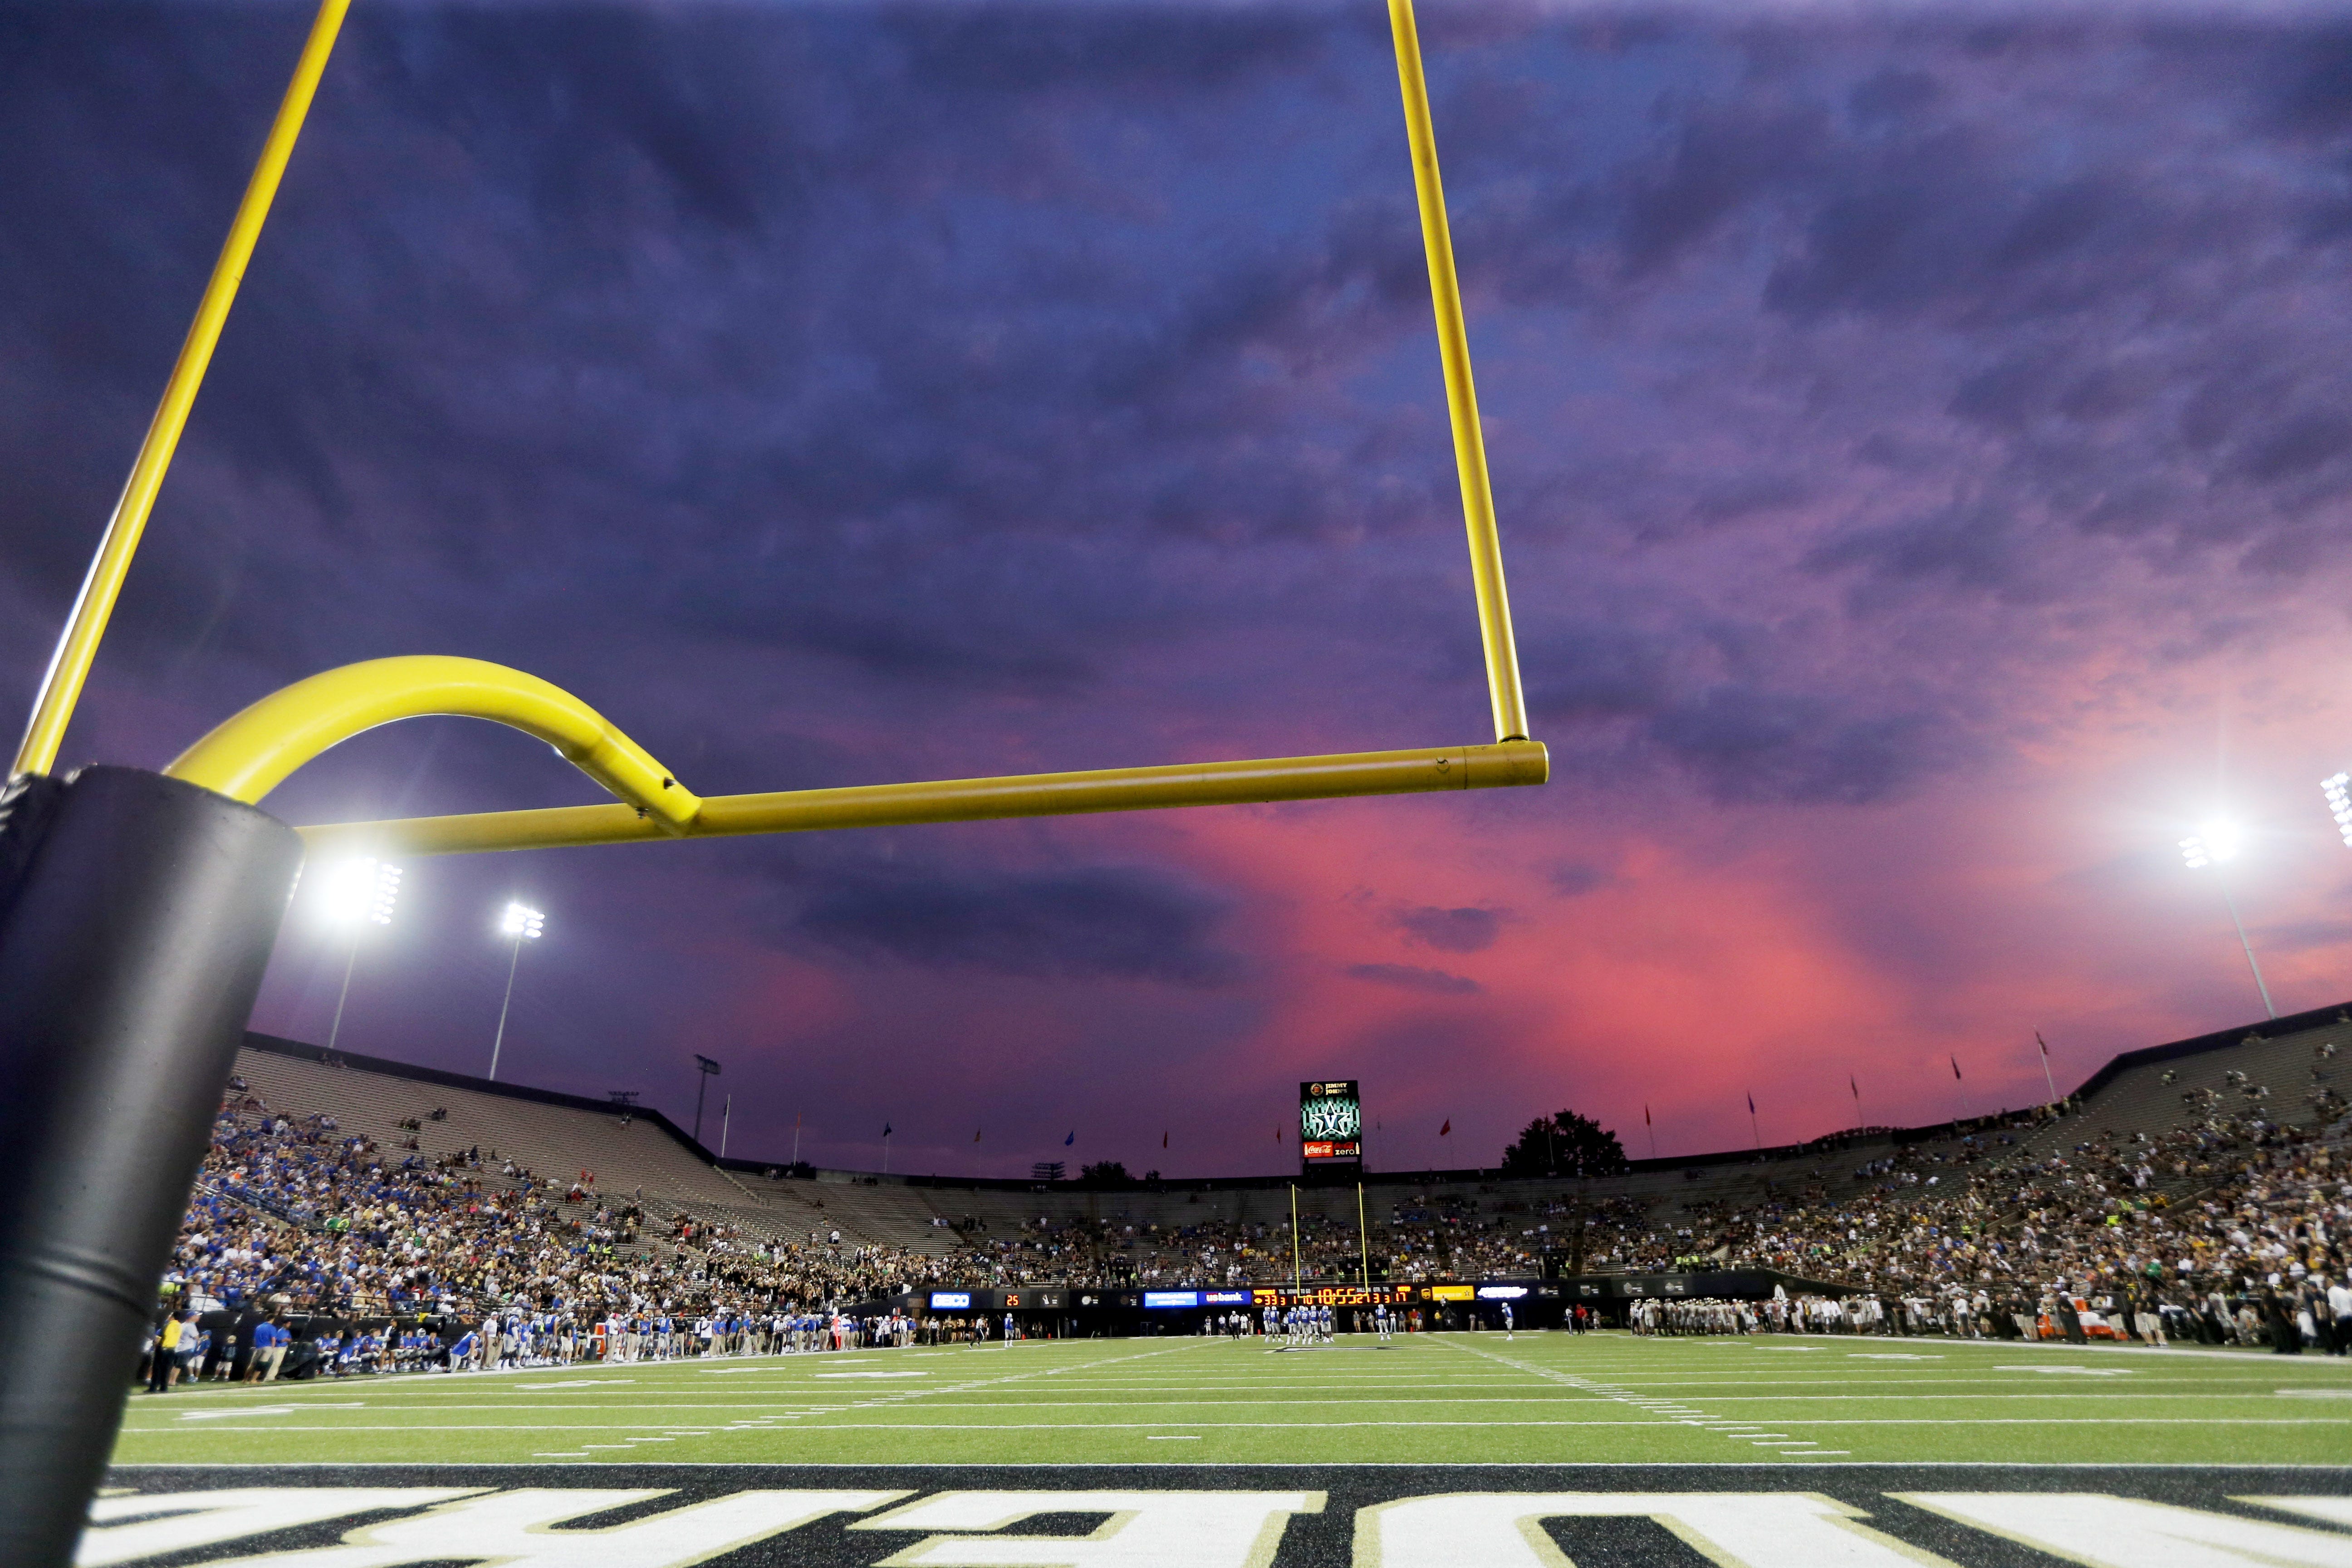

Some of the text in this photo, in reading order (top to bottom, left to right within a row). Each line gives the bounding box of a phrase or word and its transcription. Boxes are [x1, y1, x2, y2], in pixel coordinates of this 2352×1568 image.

[1324, 1115, 1337, 1128] V
[932, 1294, 970, 1307] GEICO
[1007, 1295, 1019, 1306] 25
[1264, 1295, 1277, 1305] 33
[1280, 1297, 1286, 1306] 3
[1294, 1296, 1297, 1304] 1
[1303, 1294, 1313, 1304] 10
[1373, 1293, 1380, 1303] 3
[1384, 1295, 1390, 1303] 3
[1396, 1292, 1406, 1302] 17
